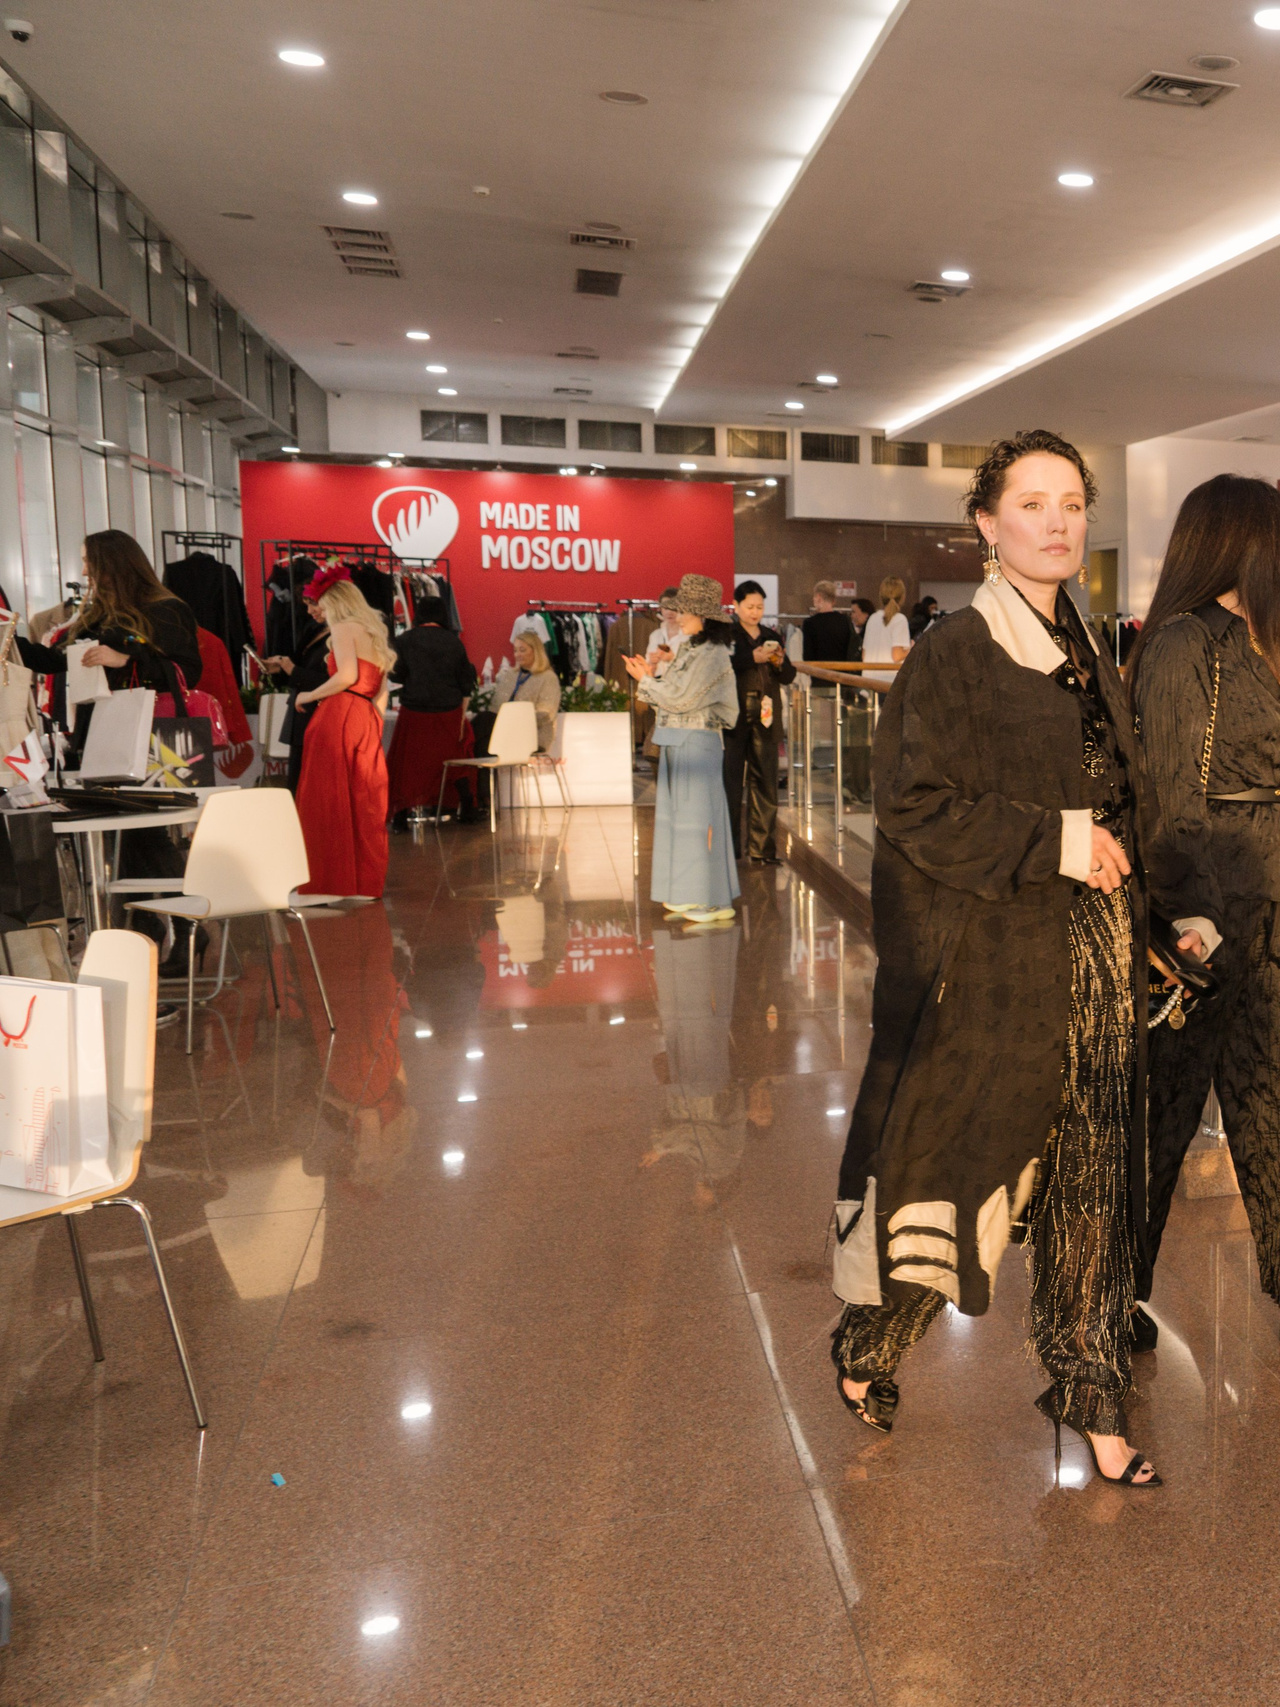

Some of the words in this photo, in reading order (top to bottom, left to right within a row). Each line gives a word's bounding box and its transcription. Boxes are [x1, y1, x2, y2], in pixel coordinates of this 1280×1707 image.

[479, 501, 551, 531] MADE
[556, 504, 580, 532] IN
[480, 534, 621, 573] MOSCOW
